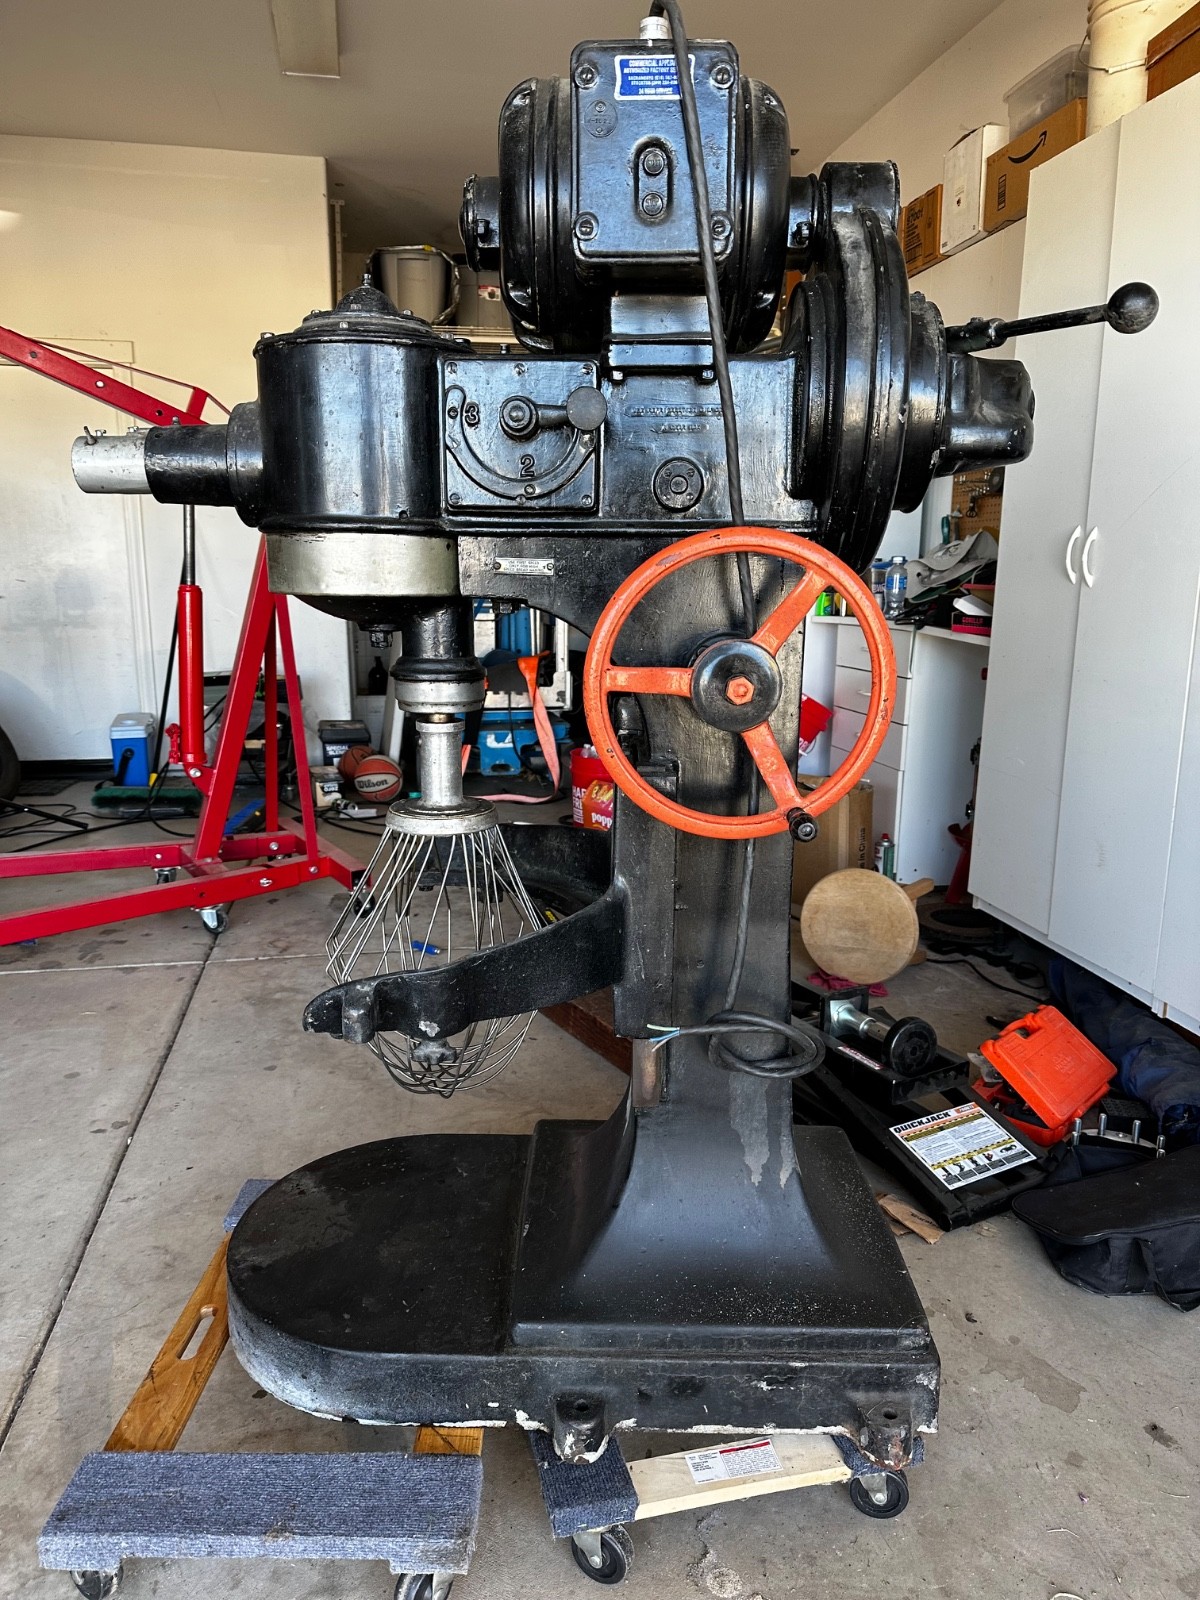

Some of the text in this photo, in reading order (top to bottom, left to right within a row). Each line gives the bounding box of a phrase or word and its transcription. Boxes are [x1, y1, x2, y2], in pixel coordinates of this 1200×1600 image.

[465, 401, 480, 427] 3
[520, 453, 535, 478] 2
[356, 779, 389, 789] Wilson
[591, 812, 612, 828] popp
[893, 1111, 951, 1134] QUICKJACK
